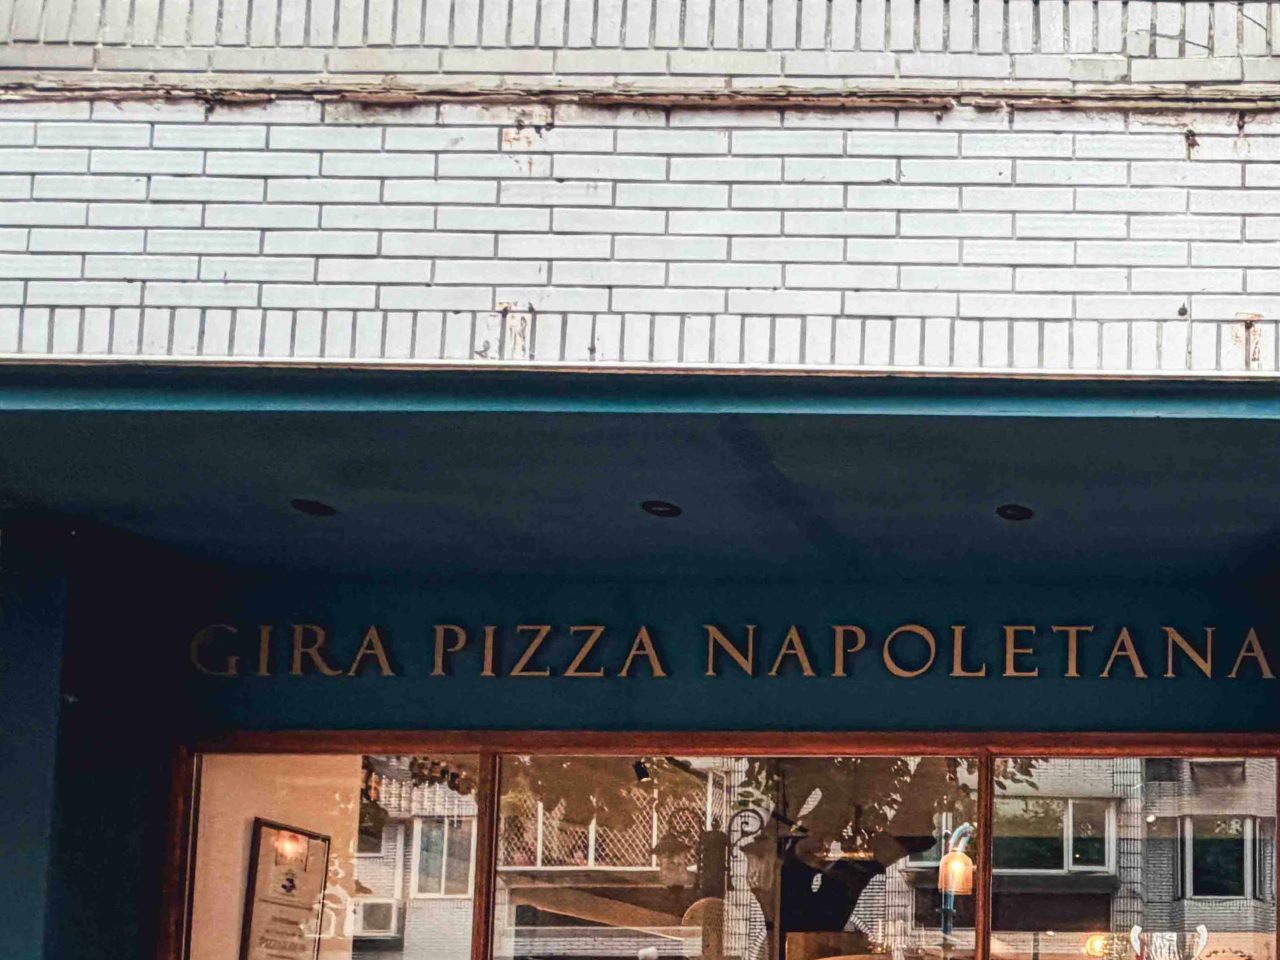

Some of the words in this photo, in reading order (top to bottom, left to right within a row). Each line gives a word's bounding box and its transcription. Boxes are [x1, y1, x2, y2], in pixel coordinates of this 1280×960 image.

[190, 623, 396, 677] GIRA
[430, 624, 667, 677] PIZZA
[703, 624, 1276, 679] NAPOLETANA
